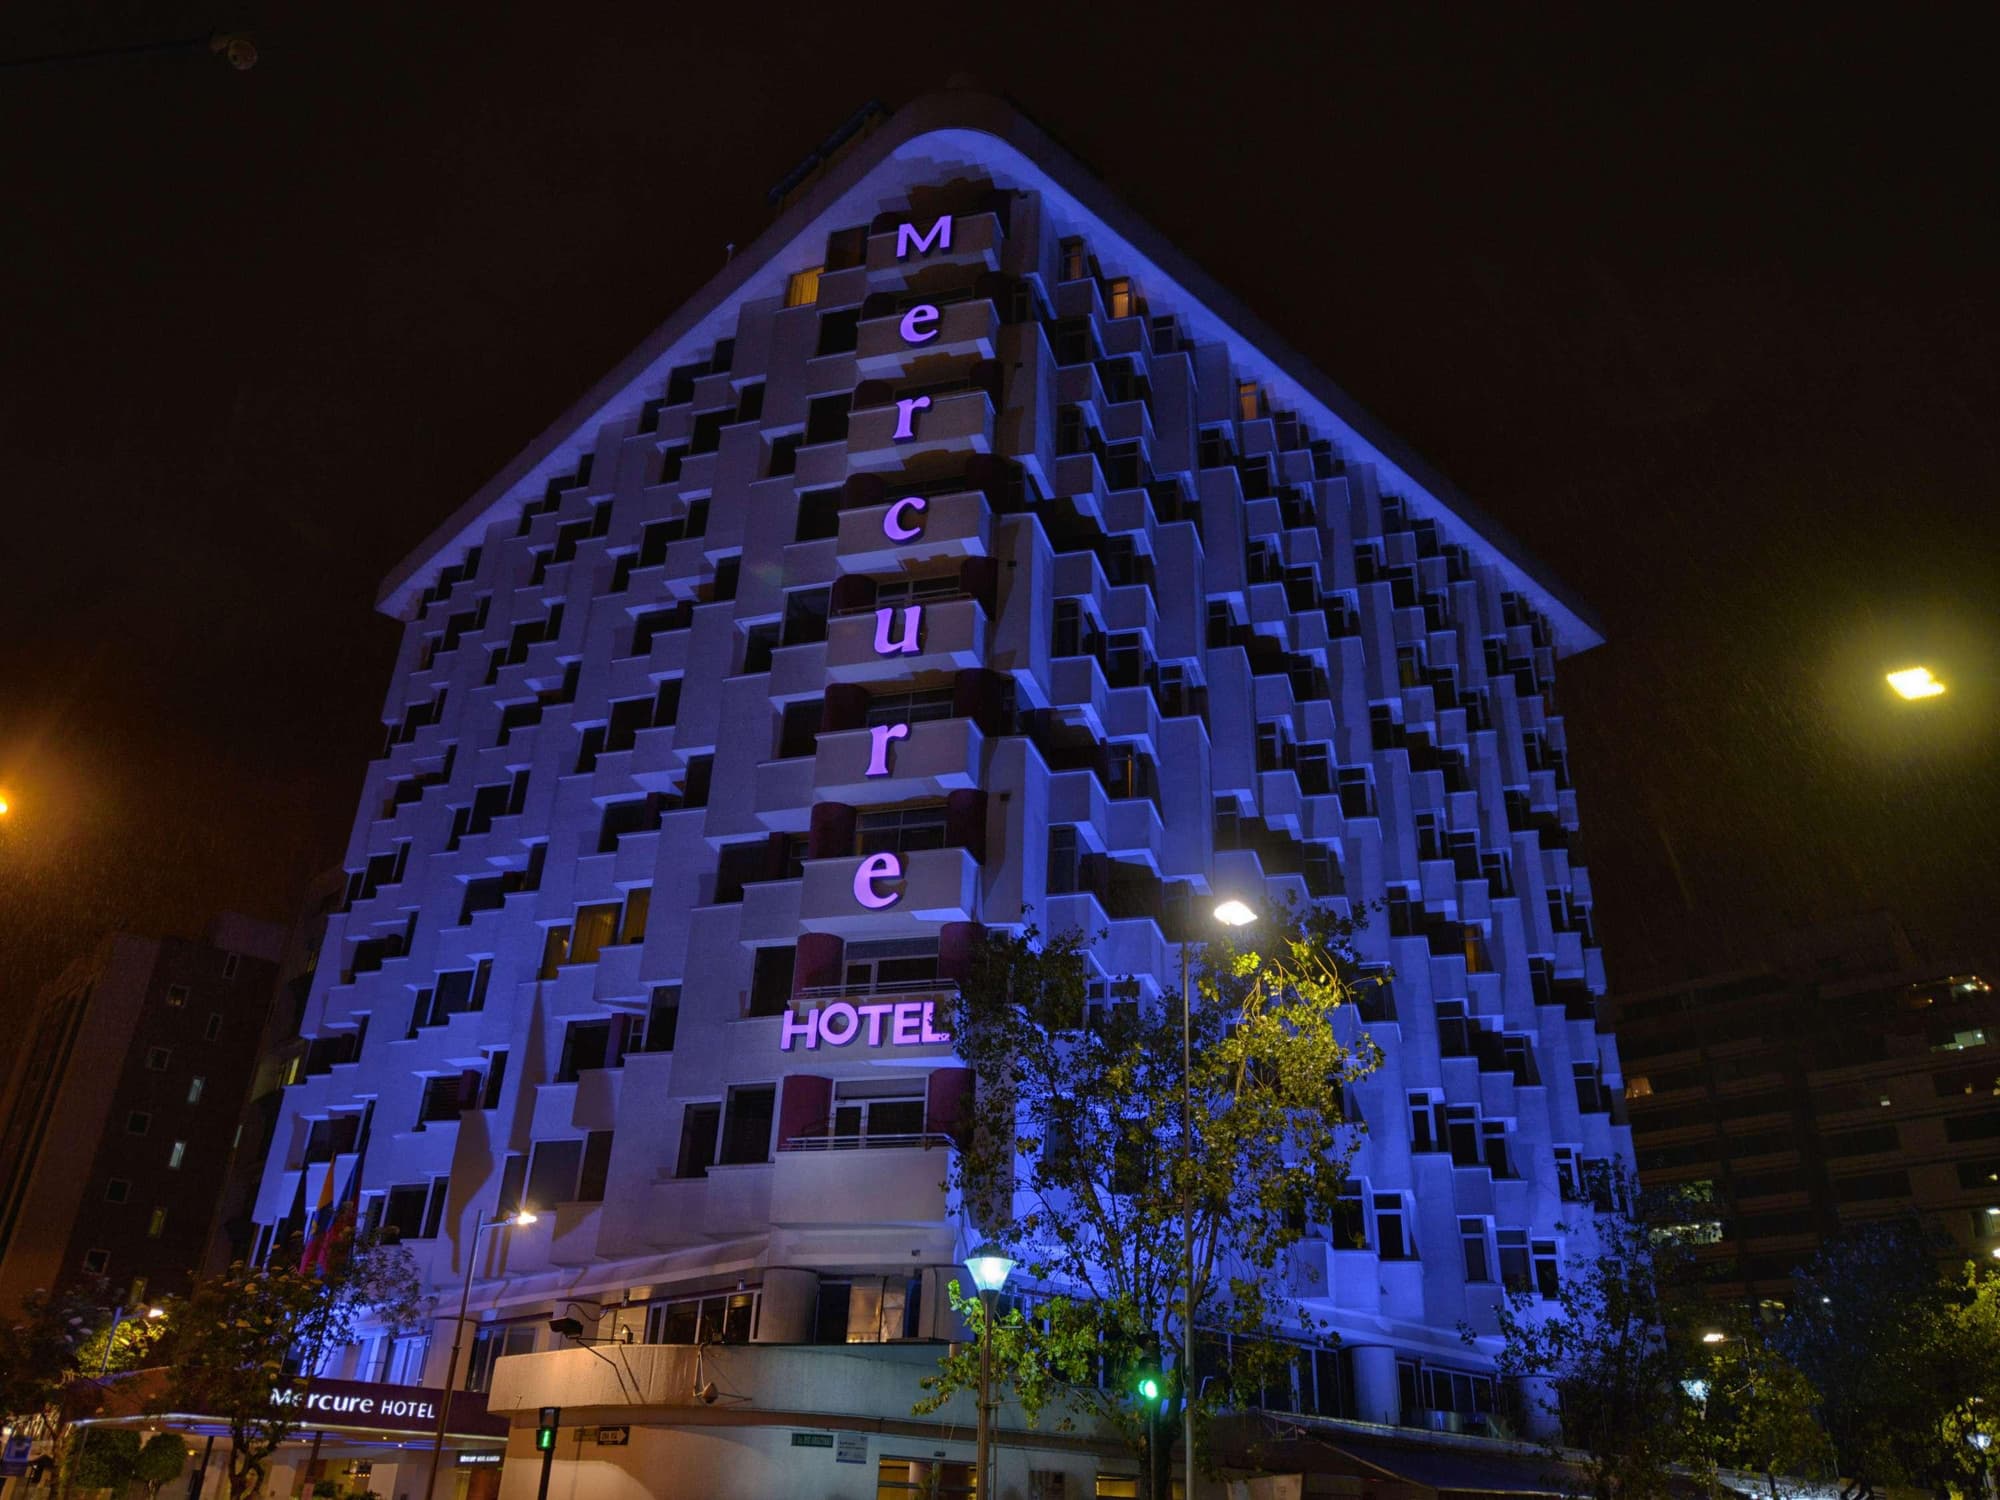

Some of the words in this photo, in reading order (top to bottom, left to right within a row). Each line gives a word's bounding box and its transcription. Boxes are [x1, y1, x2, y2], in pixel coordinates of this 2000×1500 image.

[853, 215, 953, 909] Mercure
[780, 1001, 951, 1050] HOTEL
[380, 1400, 436, 1419] HOTEL
